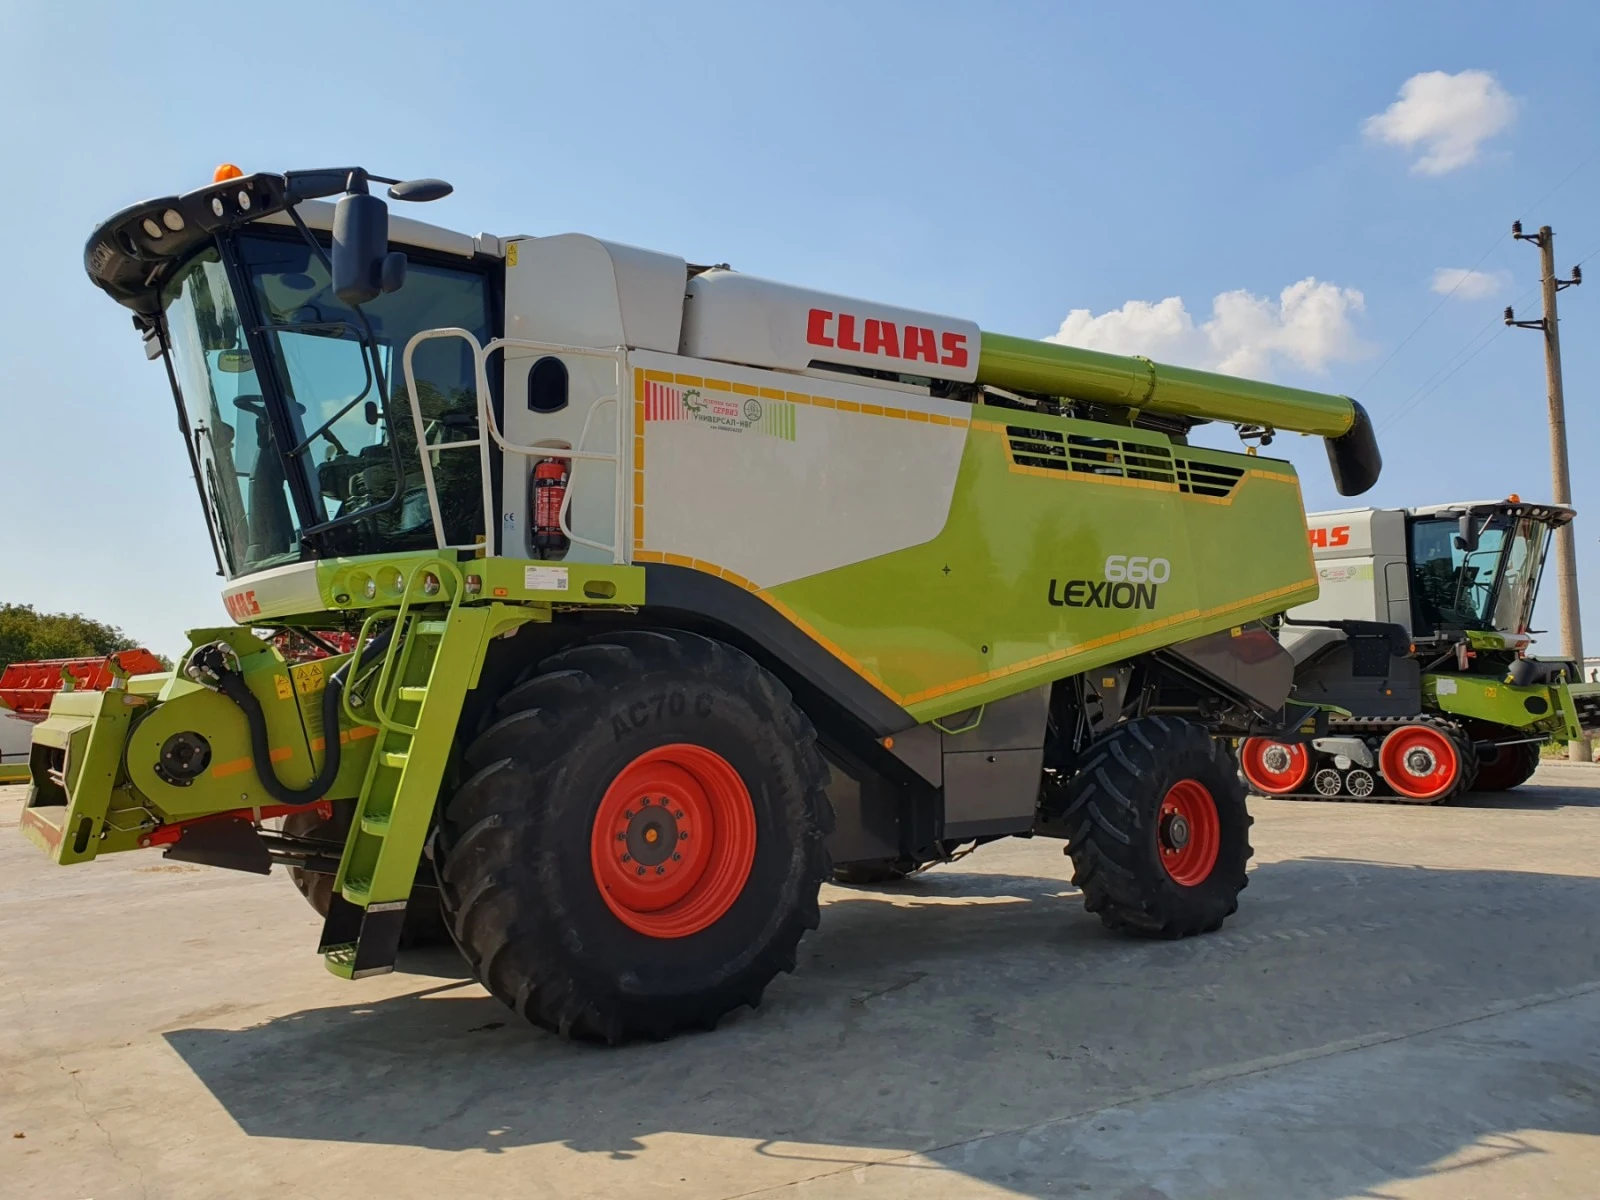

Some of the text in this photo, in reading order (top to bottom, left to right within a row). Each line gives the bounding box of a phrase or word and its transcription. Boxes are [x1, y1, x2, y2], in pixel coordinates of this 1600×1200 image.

[807, 308, 968, 368] CLAAS
[713, 406, 739, 416] СЕРВИЗ
[1104, 555, 1171, 584] 660
[1048, 579, 1157, 609] LEXION
[612, 692, 685, 742] AC70
